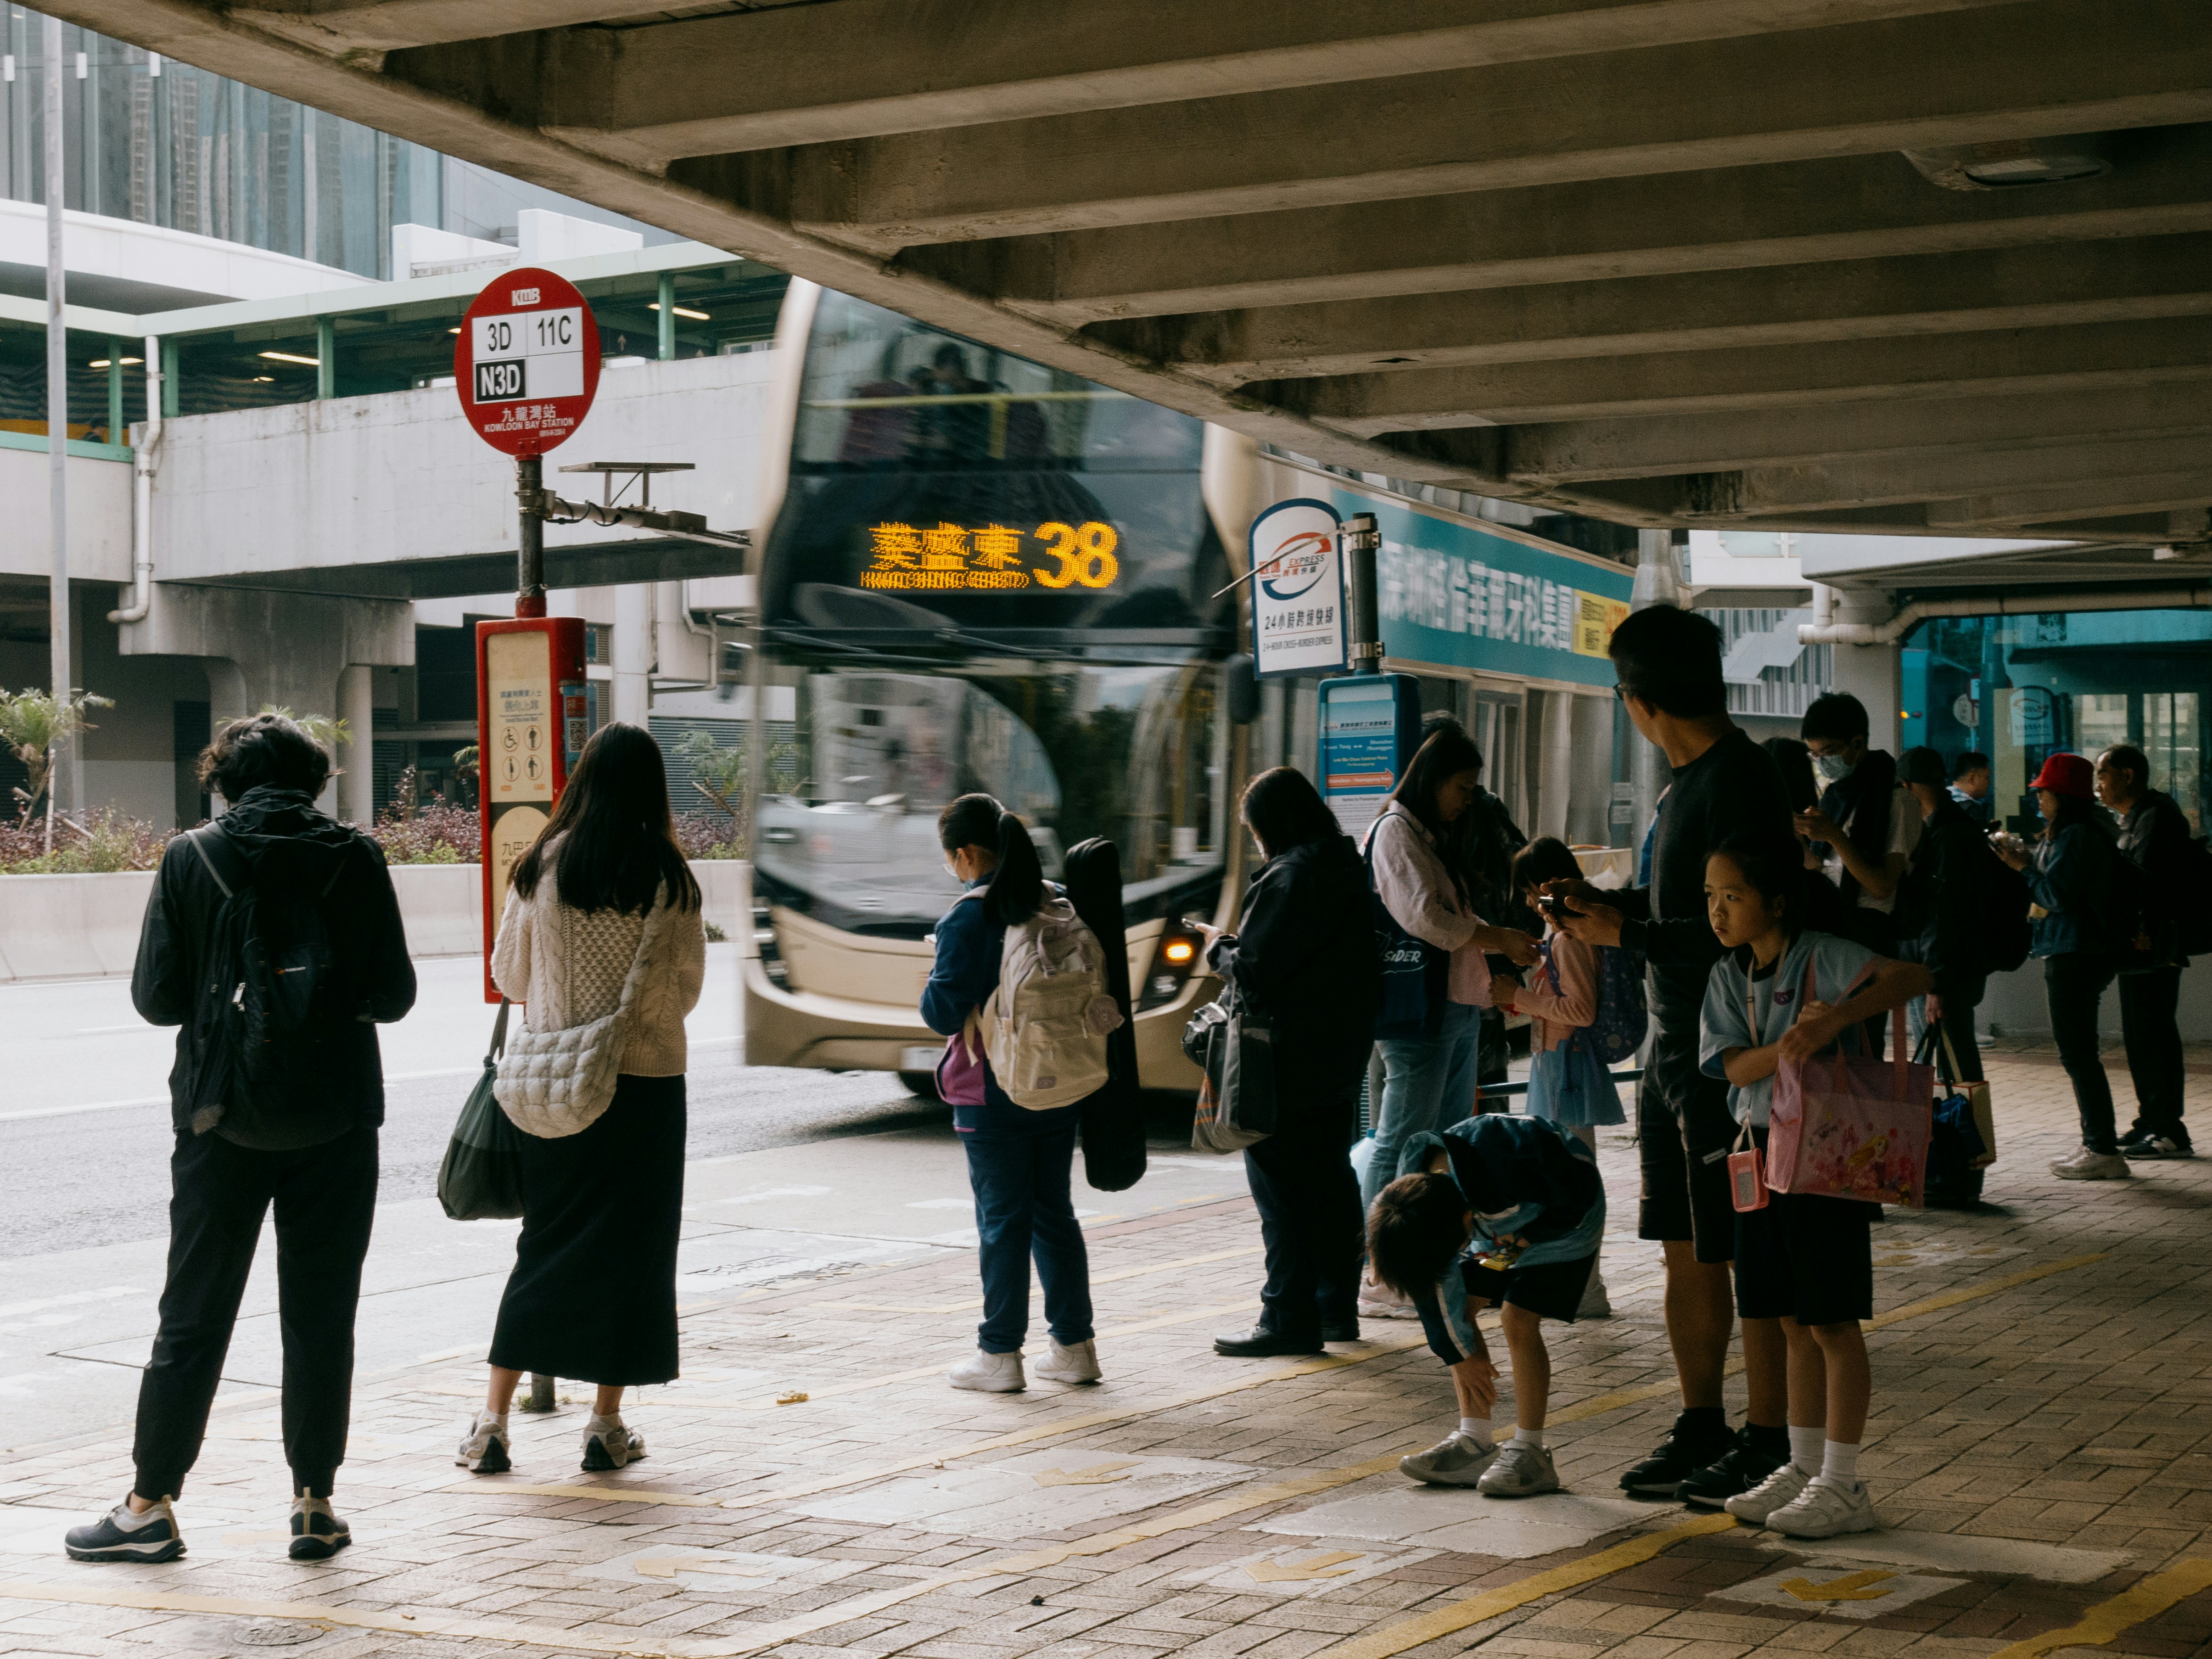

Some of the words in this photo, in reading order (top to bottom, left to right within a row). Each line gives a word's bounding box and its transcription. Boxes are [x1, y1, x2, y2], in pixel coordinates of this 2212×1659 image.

[511, 288, 541, 307] KMB
[488, 322, 511, 352] 3D
[538, 315, 572, 347] 11C
[480, 364, 521, 396] N3D
[501, 404, 556, 422] 九龍灣站
[484, 421, 523, 433] KOWLOON
[525, 419, 540, 430] BAY
[541, 417, 574, 428] STATION
[1033, 521, 1119, 588] 38
[1289, 554, 1325, 566] EXPRESS
